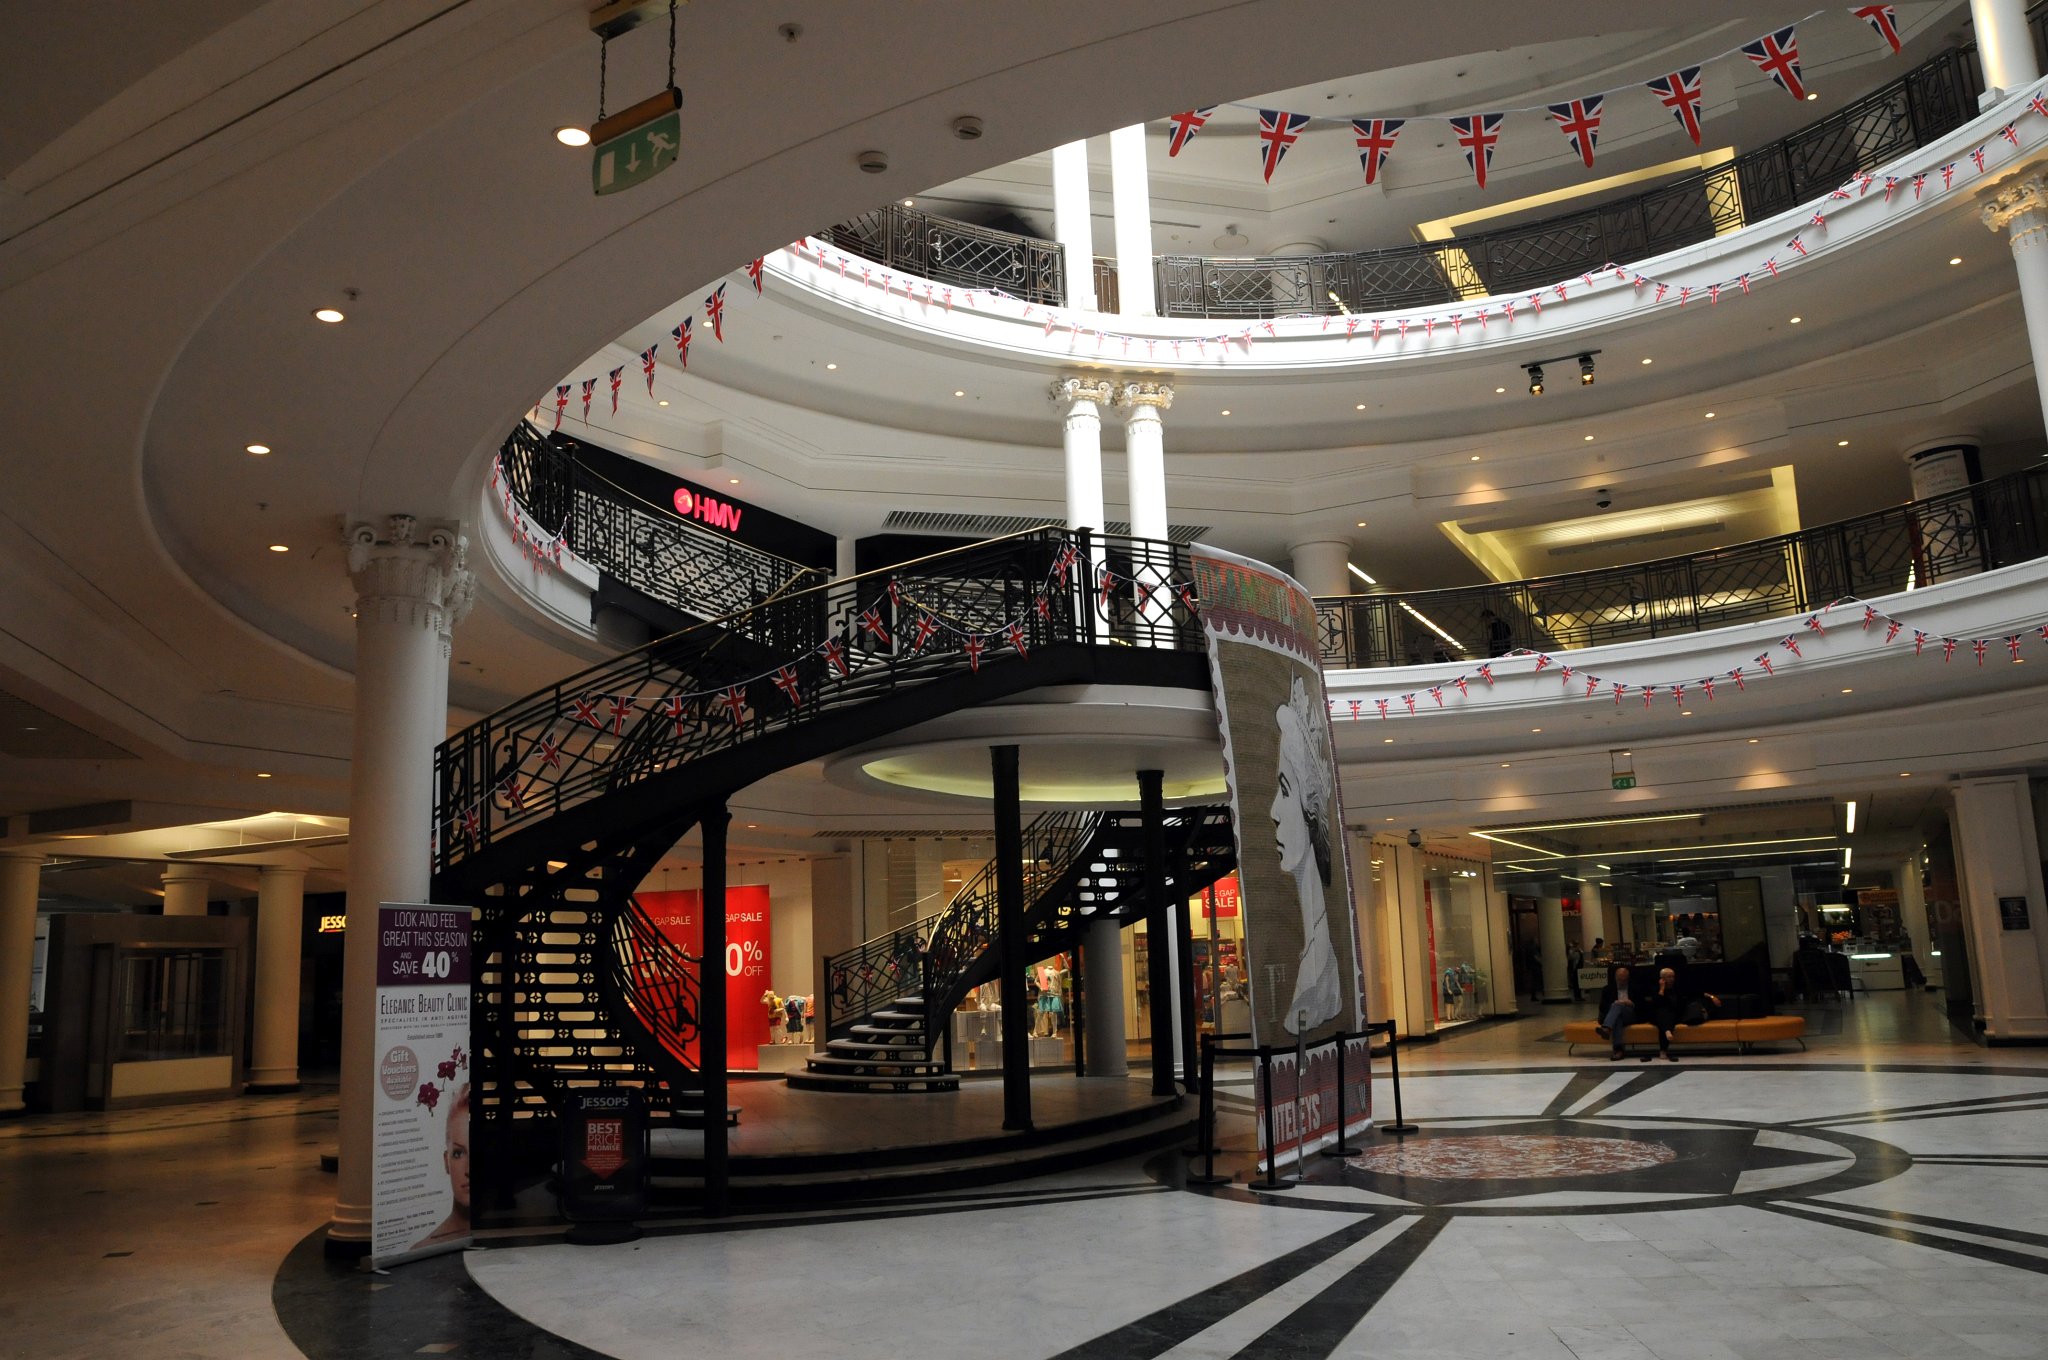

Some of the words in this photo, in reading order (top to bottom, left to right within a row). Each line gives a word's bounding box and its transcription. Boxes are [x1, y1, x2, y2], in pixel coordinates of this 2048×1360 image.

[693, 493, 742, 532] HMV
[1203, 890, 1218, 898] TE
[1219, 889, 1235, 897] GAP
[1205, 897, 1235, 909] SALE
[394, 911, 417, 927] LOOK
[419, 912, 438, 928] AND
[440, 913, 458, 929] FEEL
[655, 916, 670, 926] GAP
[670, 915, 691, 926] SALE
[741, 912, 763, 923] SALE
[383, 931, 411, 947] GREAT
[413, 931, 432, 947] THIS
[434, 931, 468, 947] SEASON
[400, 952, 412, 960] AND
[392, 960, 419, 975] SAVE
[744, 965, 764, 977] OFF
[390, 1049, 410, 1063] Gift
[381, 1063, 417, 1075] Vouchers
[580, 1096, 629, 1110] JESSOPS
[587, 1122, 621, 1134] BEST
[587, 1133, 621, 1145] PRICE
[587, 1144, 621, 1152] PROMISE
